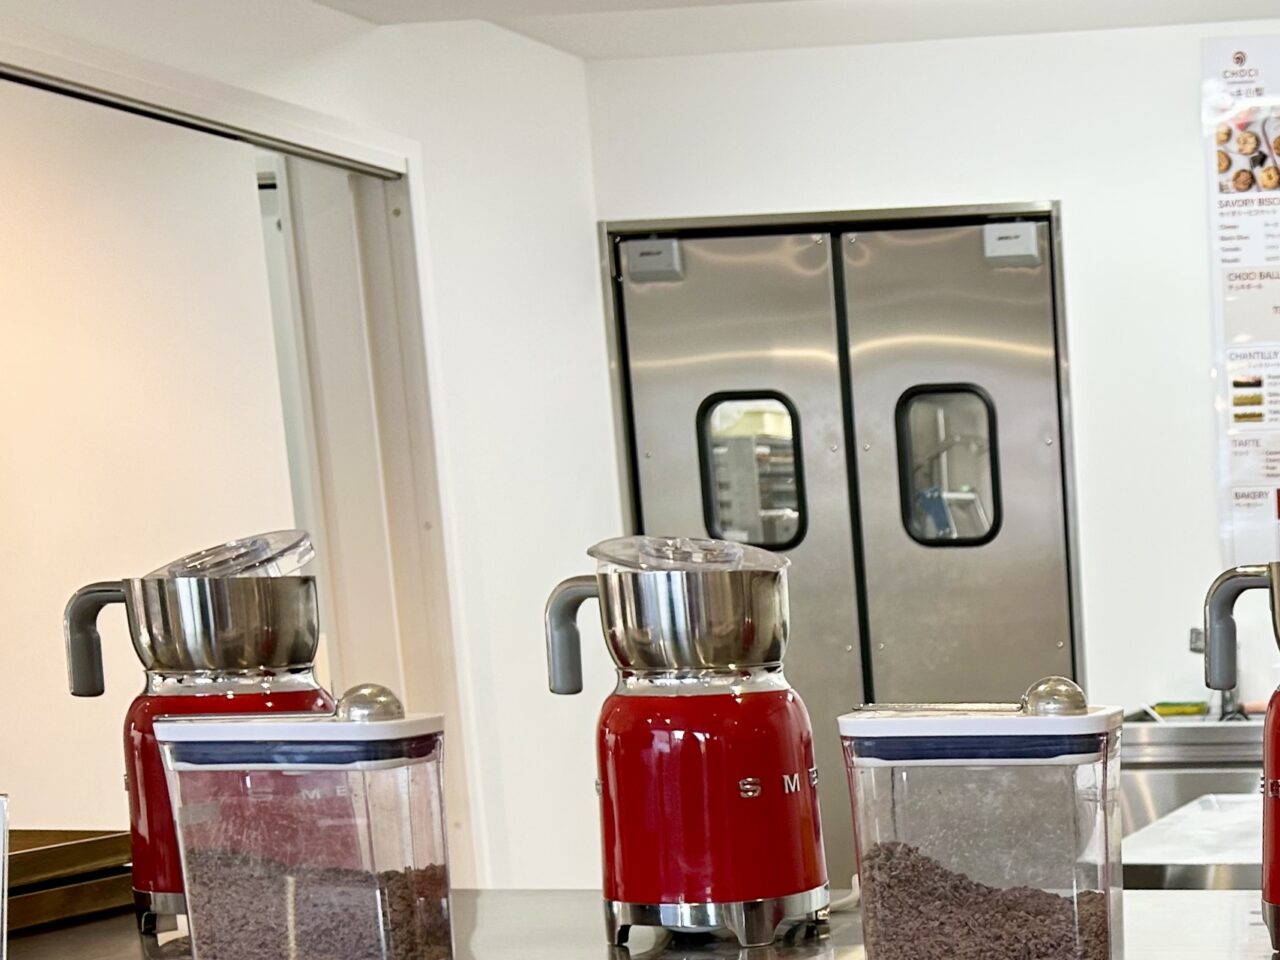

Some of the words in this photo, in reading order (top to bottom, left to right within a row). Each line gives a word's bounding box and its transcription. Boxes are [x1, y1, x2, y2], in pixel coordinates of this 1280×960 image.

[1218, 198, 1257, 209] SAVORY
[1229, 351, 1280, 361] CHANTILLY
[1232, 438, 1261, 448] TARTE
[1234, 490, 1270, 500] BAKERY
